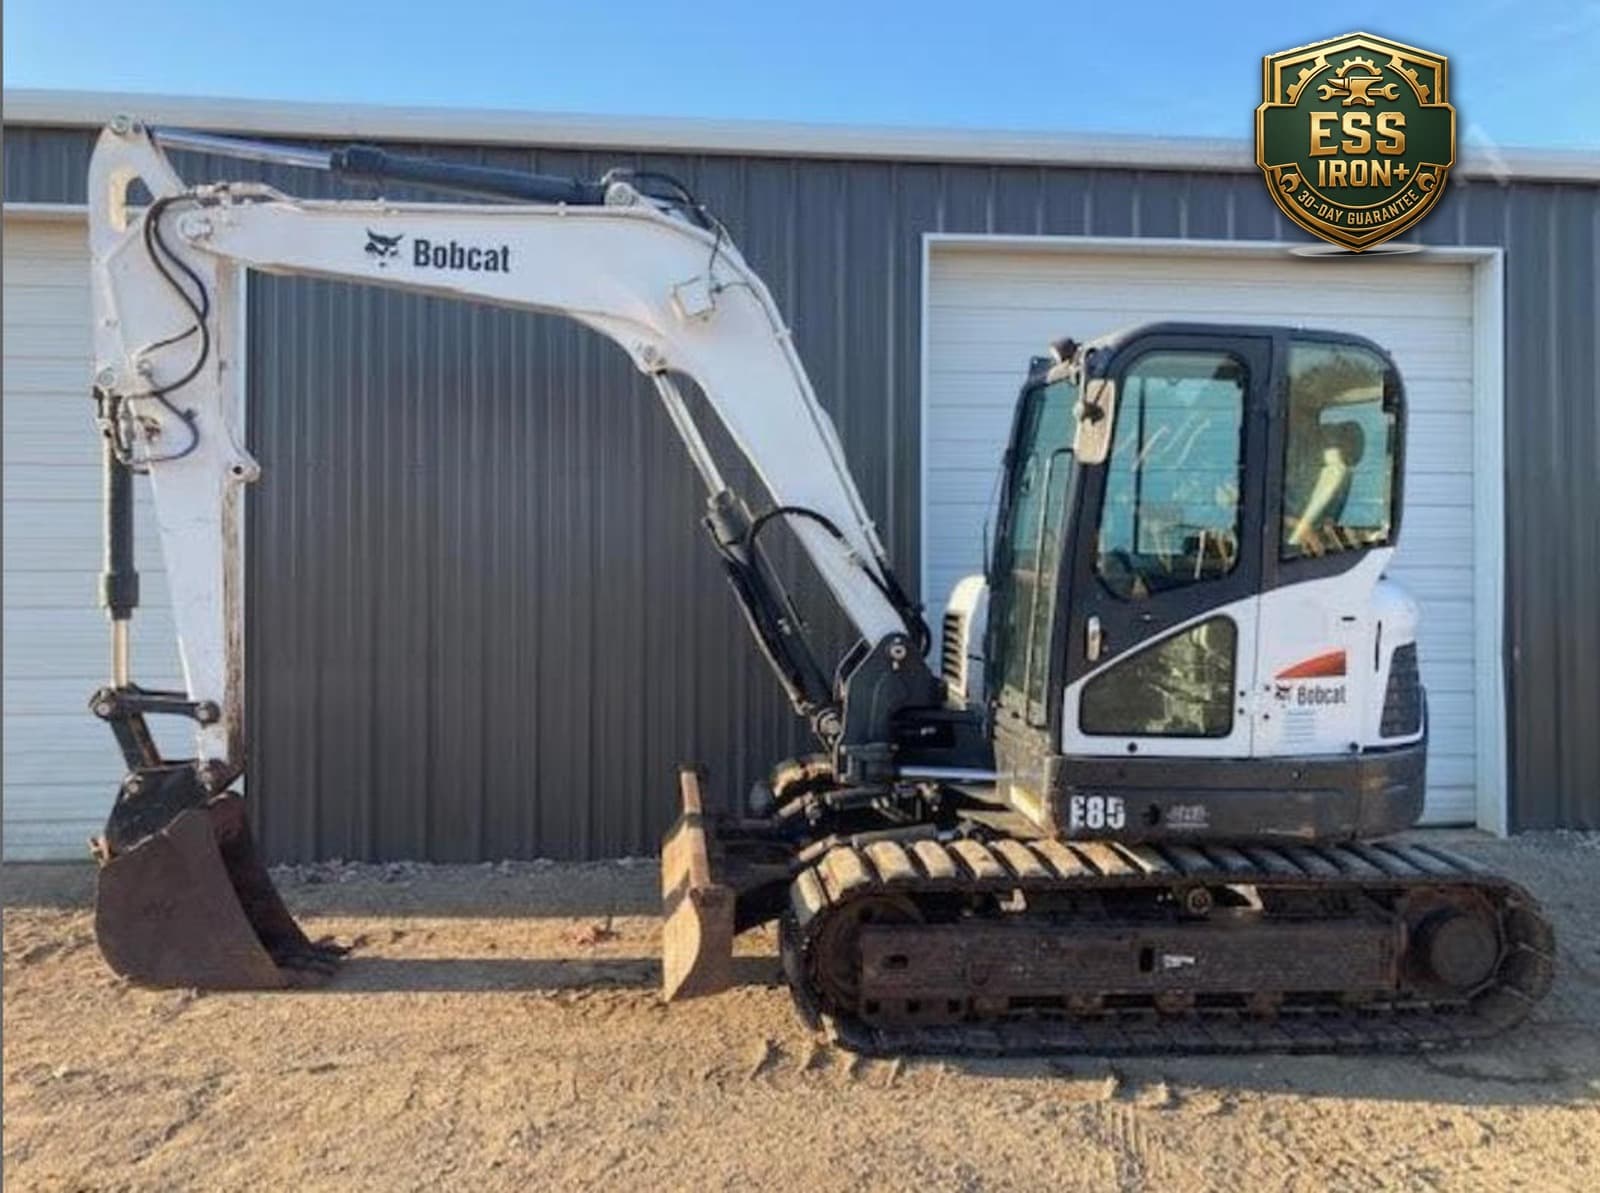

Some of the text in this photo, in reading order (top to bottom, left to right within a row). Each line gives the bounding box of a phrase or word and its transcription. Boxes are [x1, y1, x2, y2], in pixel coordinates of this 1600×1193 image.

[414, 239, 510, 272] Bobcat
[1297, 685, 1346, 706] Bobcat
[1070, 795, 1126, 831] E85
